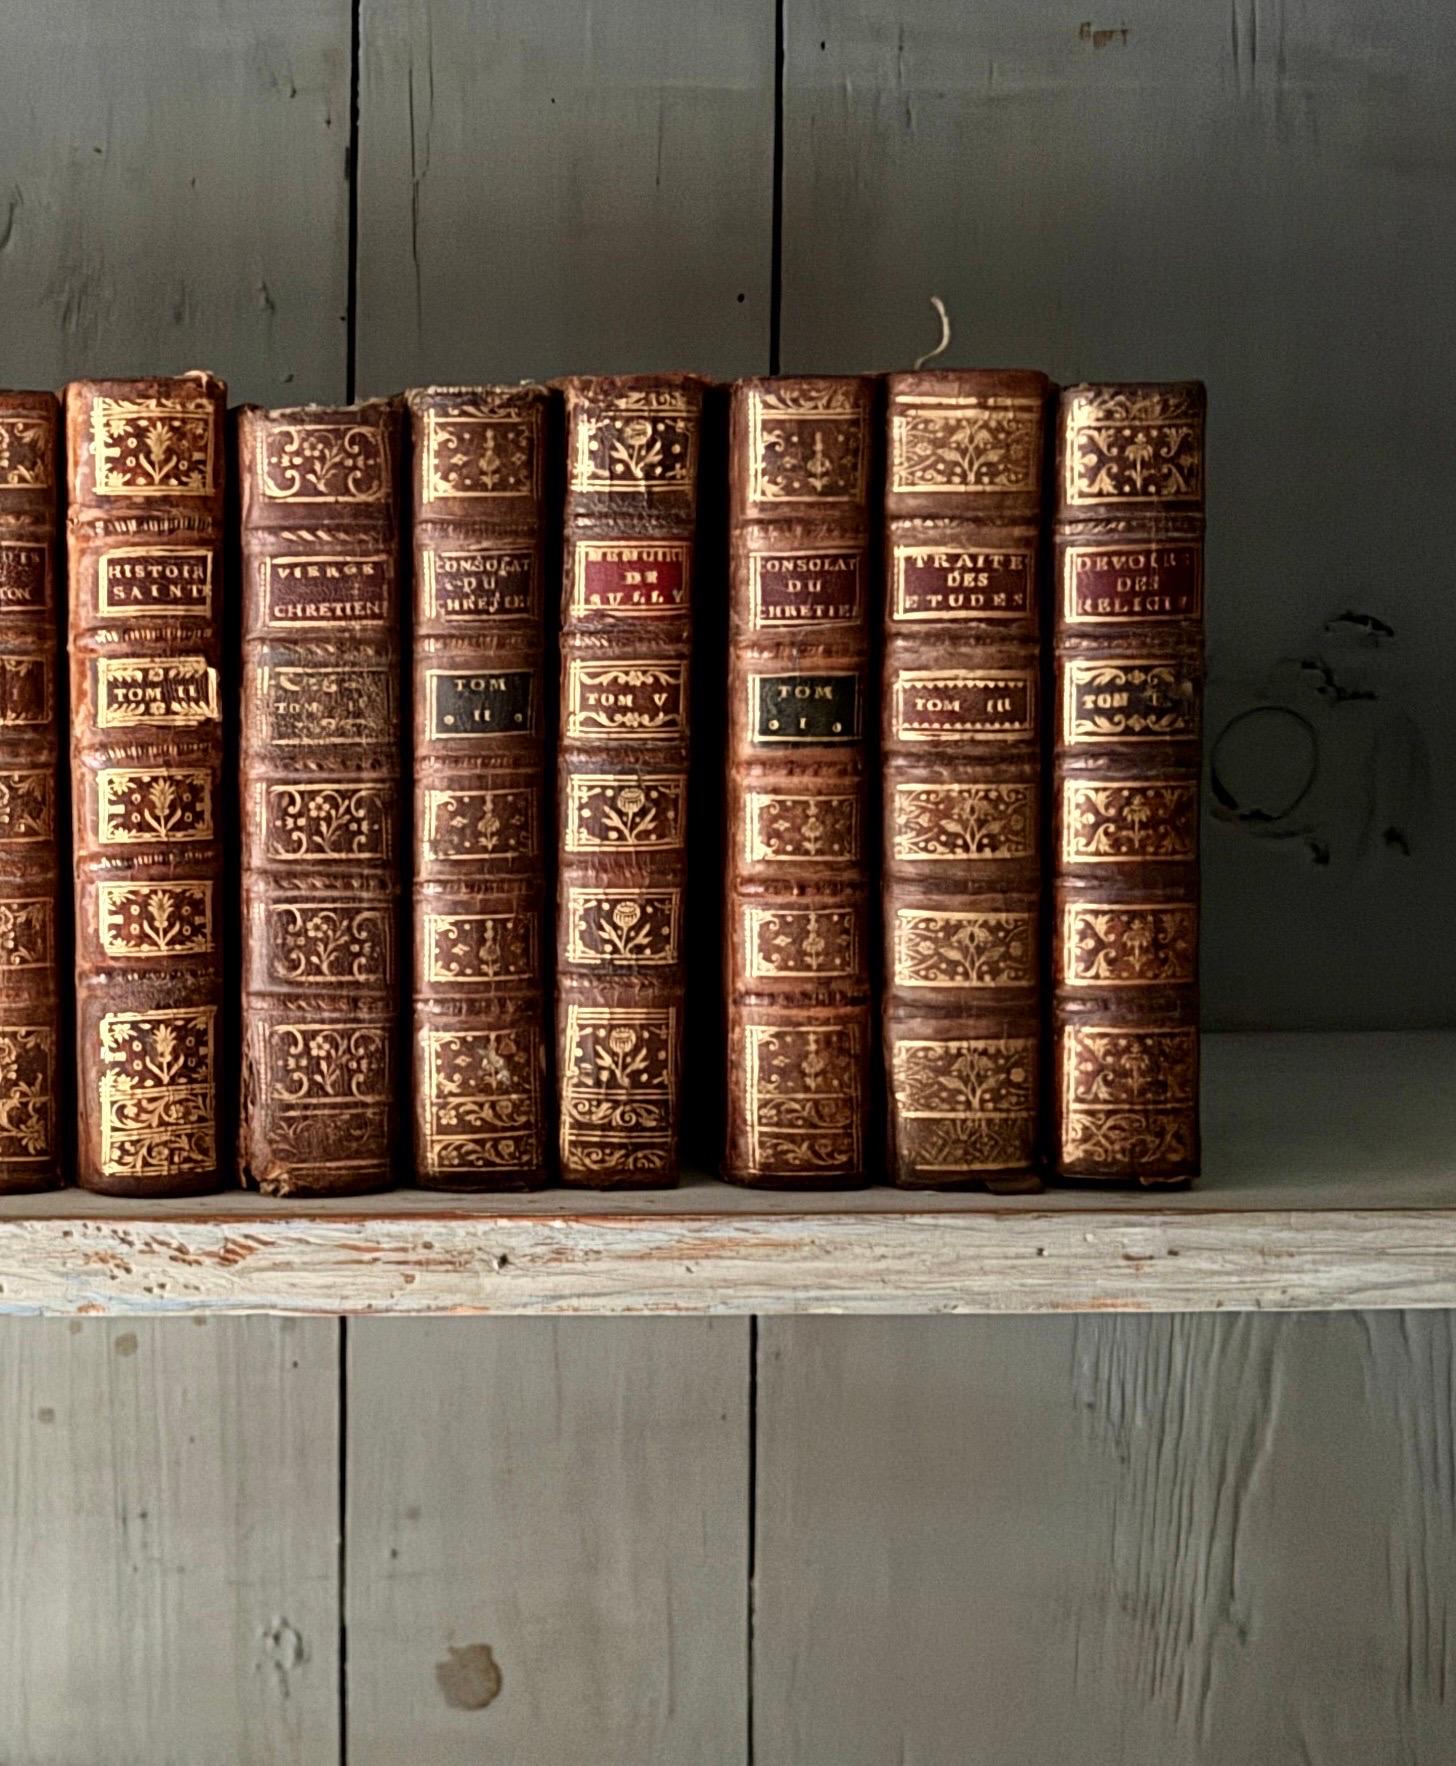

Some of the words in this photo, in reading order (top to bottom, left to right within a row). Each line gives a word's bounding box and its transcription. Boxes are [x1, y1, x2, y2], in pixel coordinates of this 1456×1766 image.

[276, 564, 375, 578] VIERGE
[624, 571, 658, 585] DE
[947, 569, 989, 587] DES
[463, 576, 495, 593] DU
[786, 580, 822, 593] DU
[274, 601, 381, 618] CHRETIEN
[454, 678, 507, 692] TOM
[777, 685, 832, 699] TOM
[113, 687, 163, 701] TOM
[177, 685, 197, 698] II
[585, 692, 633, 707] TOM
[653, 692, 669, 706] V
[914, 698, 960, 712] TOM
[986, 697, 1012, 713] III
[1082, 692, 1129, 709] TOM
[274, 702, 319, 714] TOM
[473, 709, 491, 722] II
